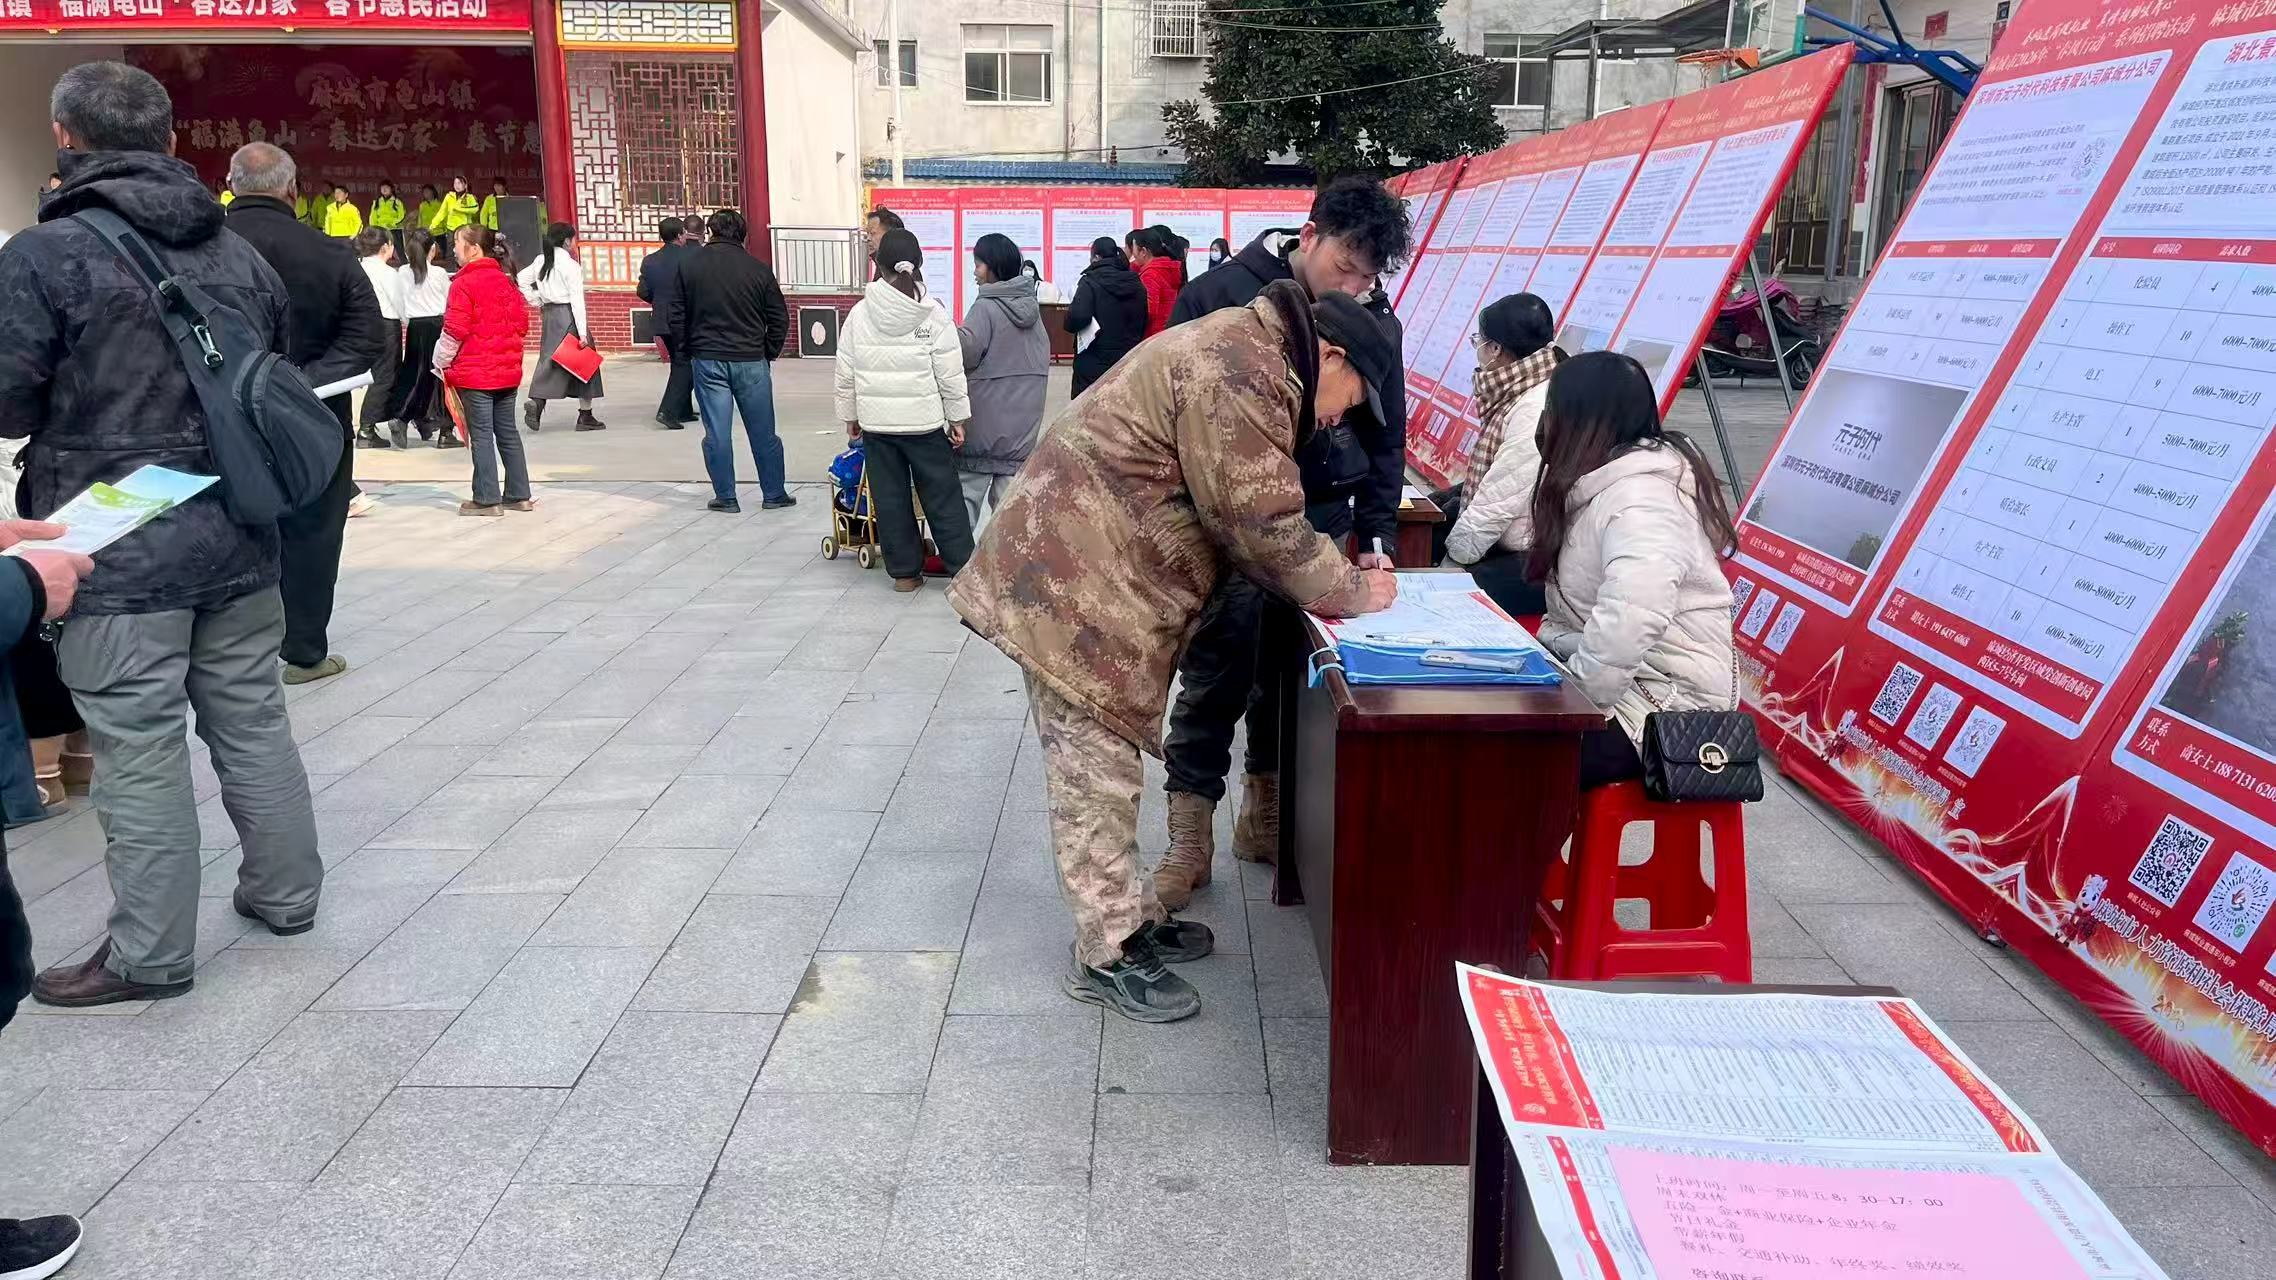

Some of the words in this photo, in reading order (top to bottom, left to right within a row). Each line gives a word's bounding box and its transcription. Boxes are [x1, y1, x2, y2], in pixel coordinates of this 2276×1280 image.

[308, 76, 480, 111] 麻城市龟山镇
[1976, 57, 2163, 105] 深圳市元子时代科技有限公司麻城分公司
[2180, 330, 2193, 342] 10
[2192, 385, 2262, 407] 6000-7000元/月
[1834, 422, 1883, 453] 元子时代
[2162, 432, 2231, 458] 5000-7000元/月
[1781, 454, 1902, 506] 深圳市元子时代科技有限公司麻城分公司
[2133, 482, 2199, 510] 4000-5000元/月
[2104, 530, 2168, 560] 4000-6000元/月
[2074, 577, 2137, 610] 6000-8000元/月
[2045, 624, 2105, 659] 6000-7000元/月
[2147, 717, 2172, 738] 联系
[2136, 733, 2161, 756] 方式
[2212, 760, 2234, 778] 188
[2231, 768, 2258, 791] 7131
